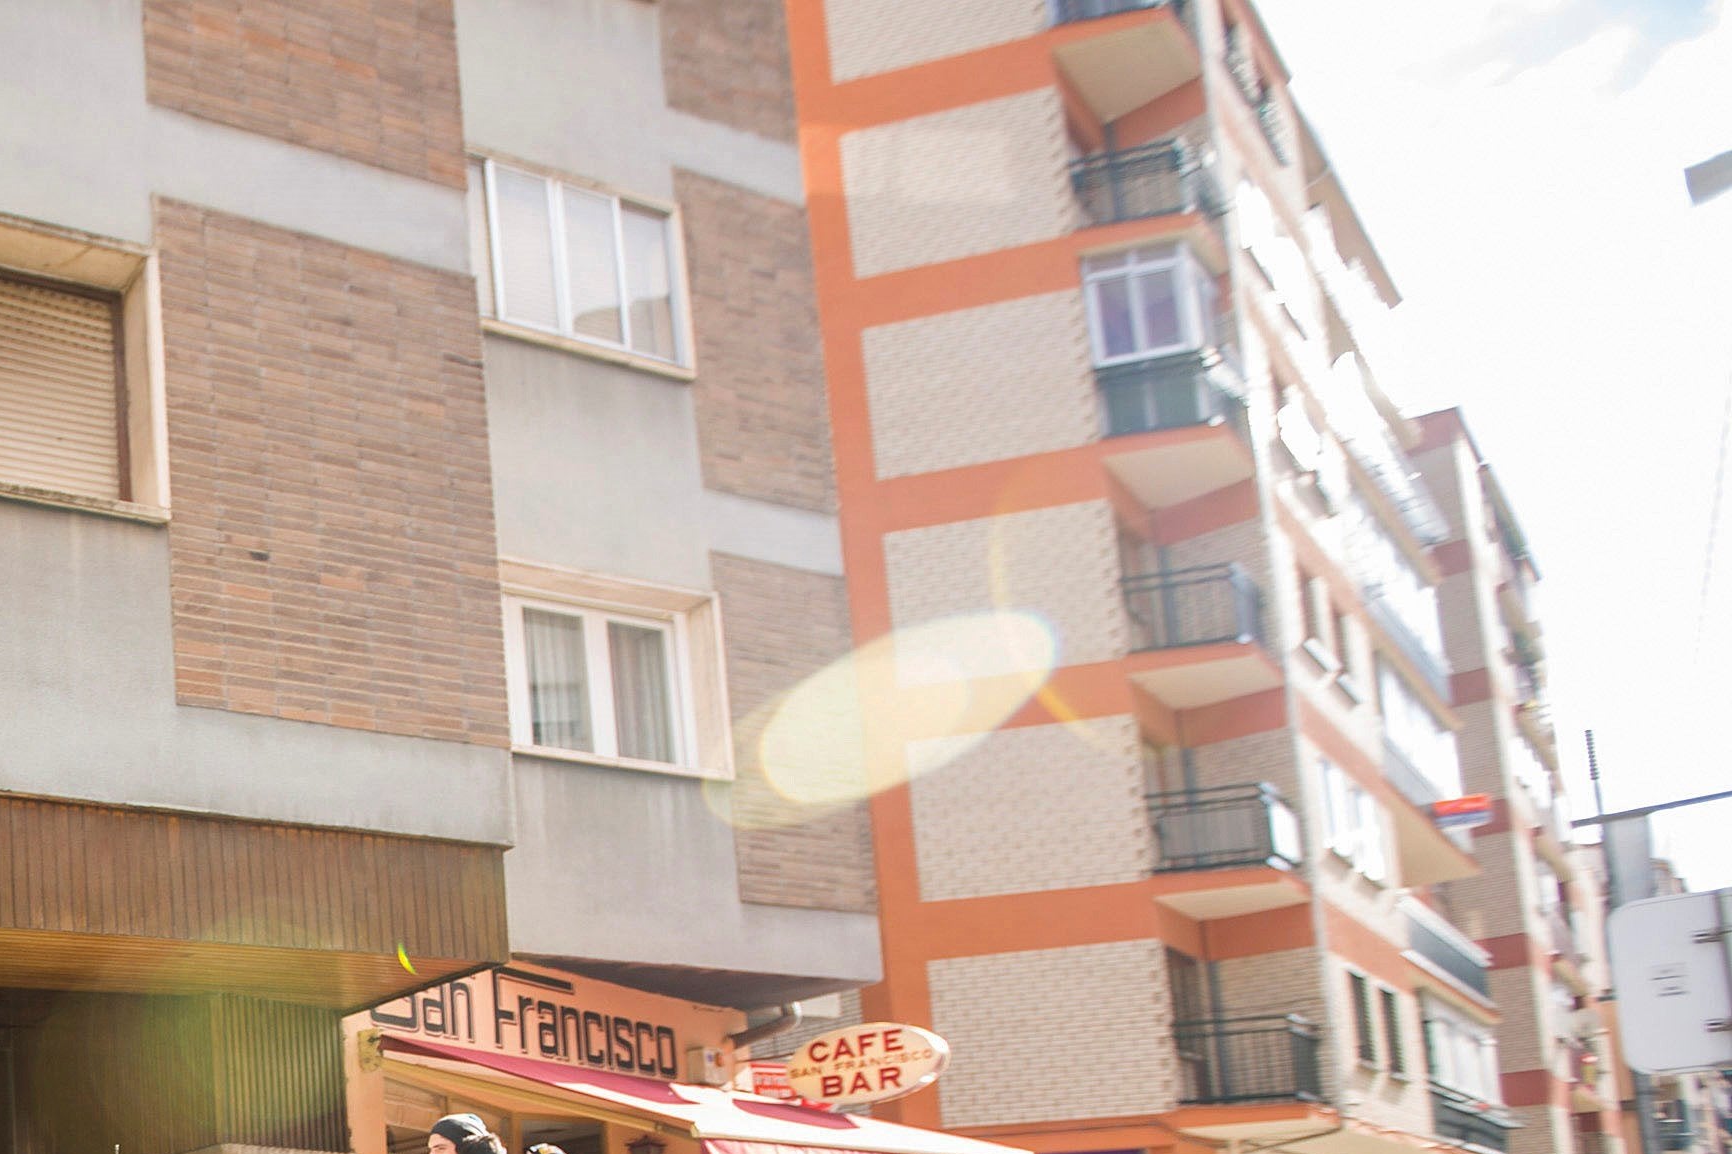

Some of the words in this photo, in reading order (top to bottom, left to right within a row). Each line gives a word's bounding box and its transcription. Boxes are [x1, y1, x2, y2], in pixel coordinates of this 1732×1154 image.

[492, 967, 677, 1078] Francisco
[808, 1029, 904, 1063] CAFE
[789, 1066, 822, 1079] SAN
[834, 1049, 933, 1073] FRANCISCO
[821, 1067, 901, 1098] BAR
